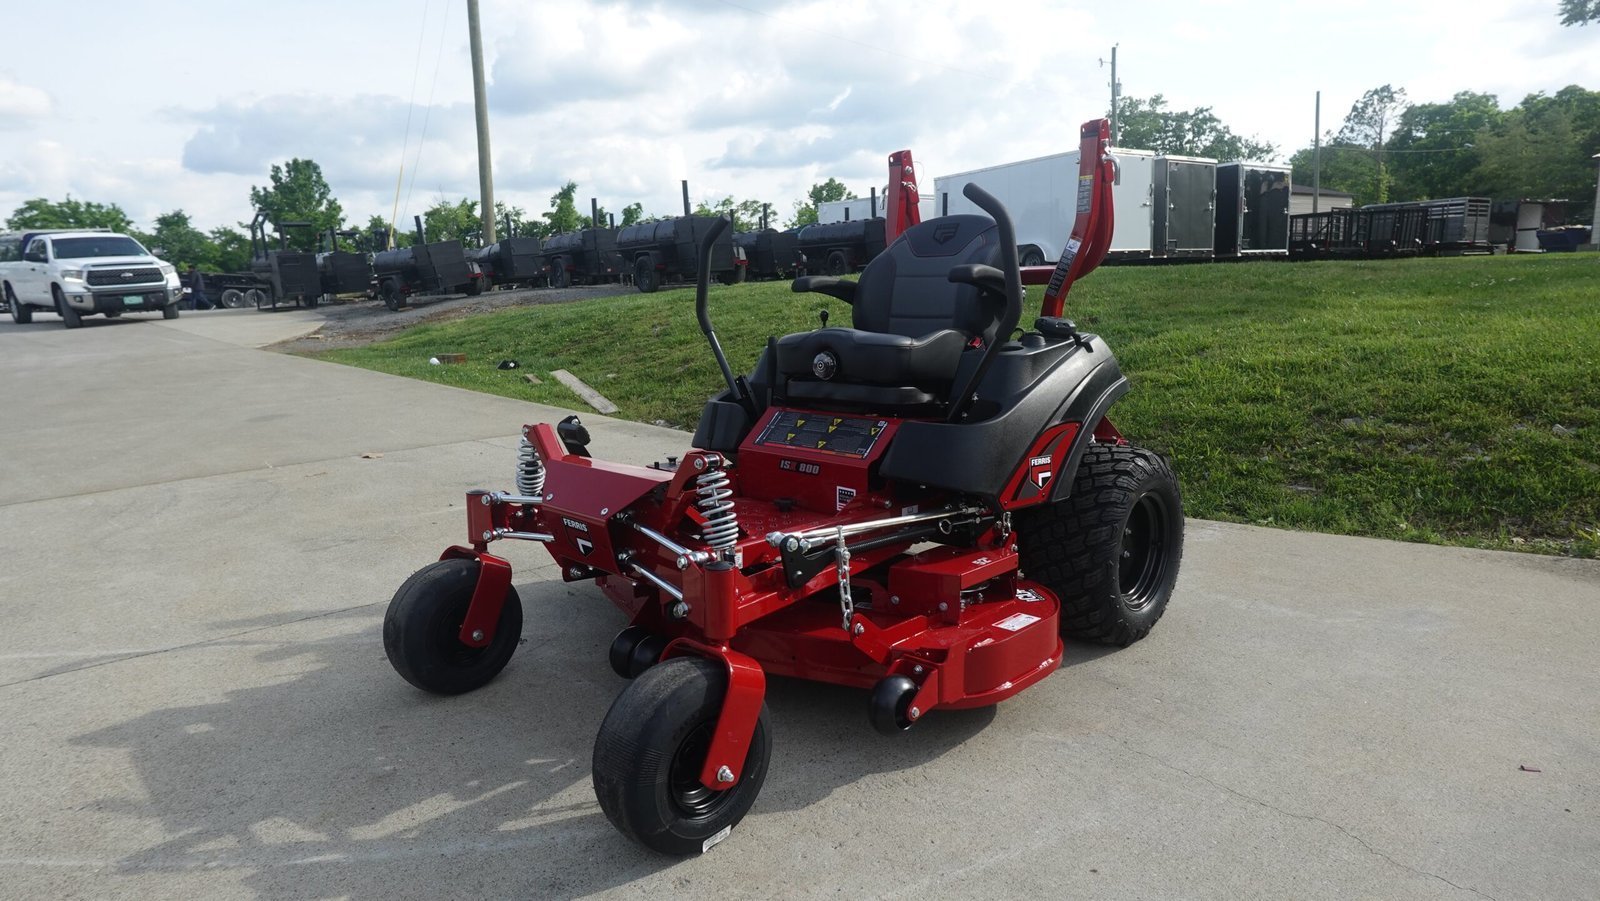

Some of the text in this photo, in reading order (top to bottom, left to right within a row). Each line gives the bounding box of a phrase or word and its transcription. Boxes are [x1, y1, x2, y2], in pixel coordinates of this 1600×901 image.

[1031, 457, 1051, 466] FERRIS
[799, 463, 820, 474] 800
[563, 517, 588, 532] FERRIS
